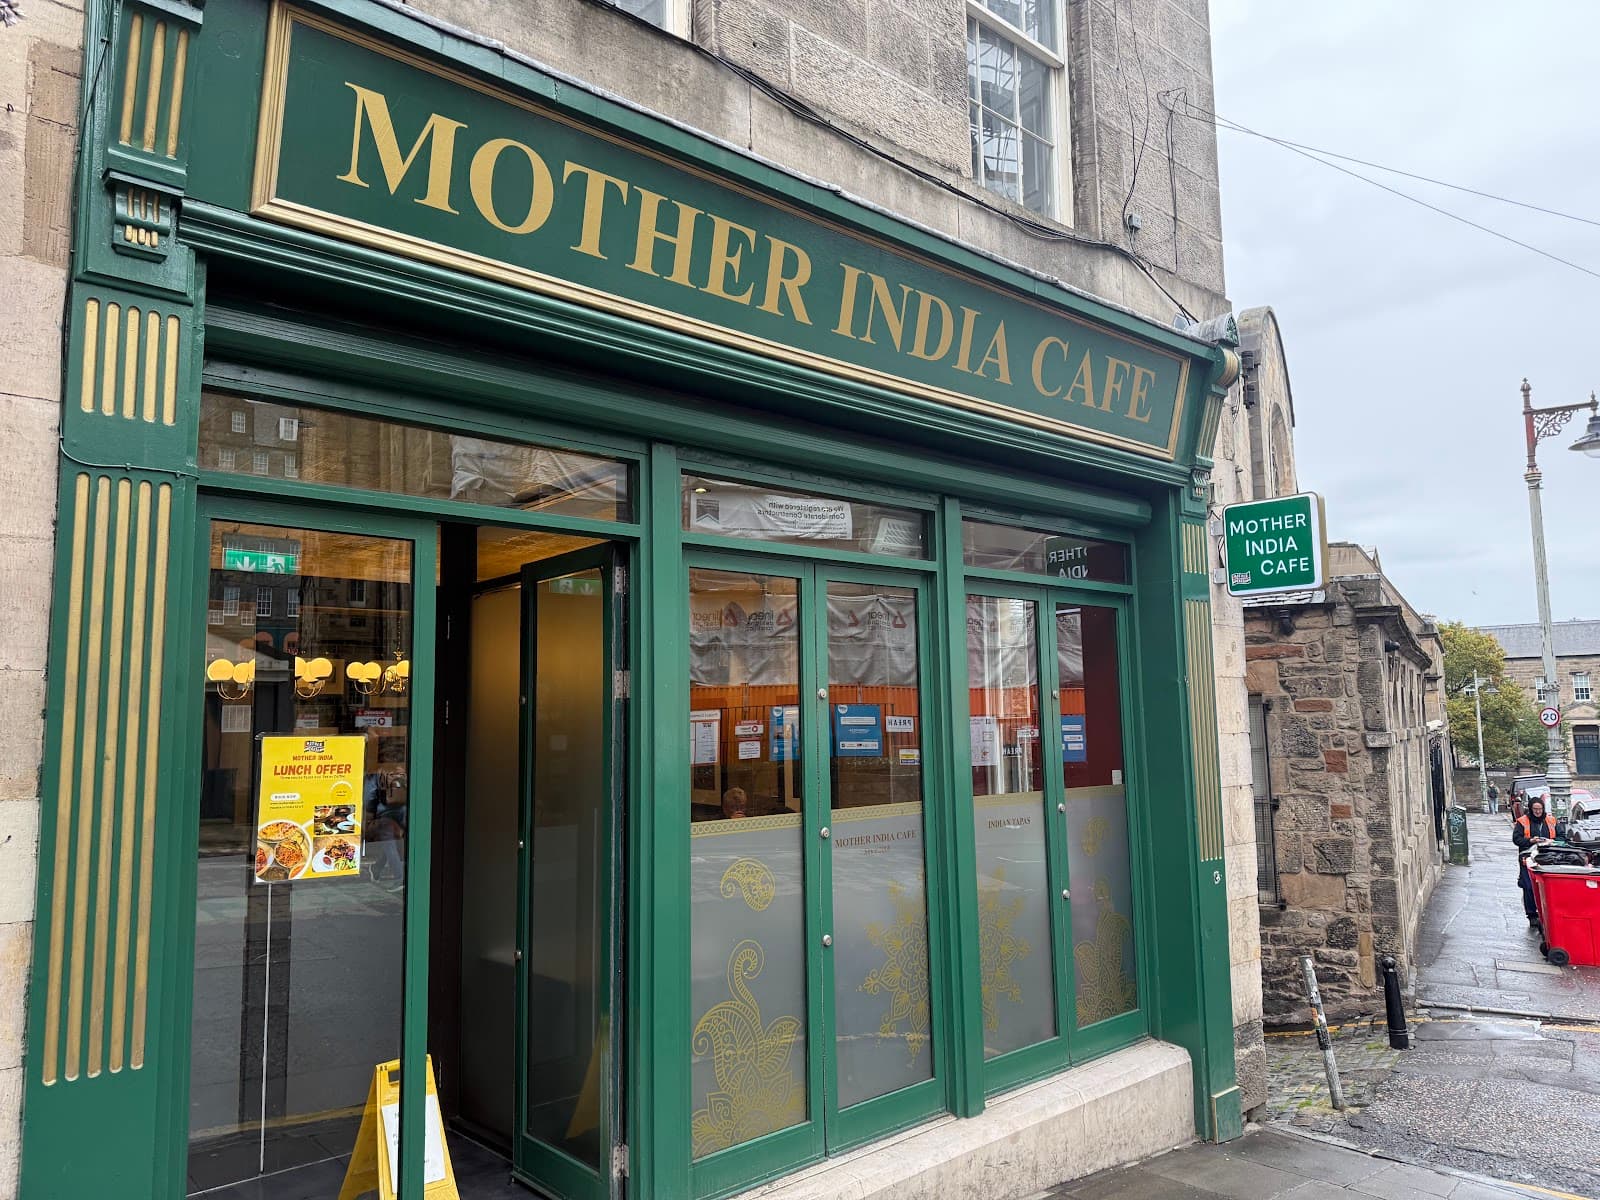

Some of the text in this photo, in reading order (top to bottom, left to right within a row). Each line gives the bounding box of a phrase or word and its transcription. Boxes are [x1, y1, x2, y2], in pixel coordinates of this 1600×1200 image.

[336, 81, 1157, 423] MOTHER INDIA CAFE
[1230, 513, 1307, 537] MOTHER
[1245, 536, 1298, 557] INDIA
[1260, 557, 1310, 576] CAFE
[1542, 713, 1557, 721] 20
[274, 764, 352, 776] LUNCH OFFER
[988, 816, 1031, 829] INDIAN TAPAS
[835, 829, 917, 848] MOTHER INDIA CAFE
